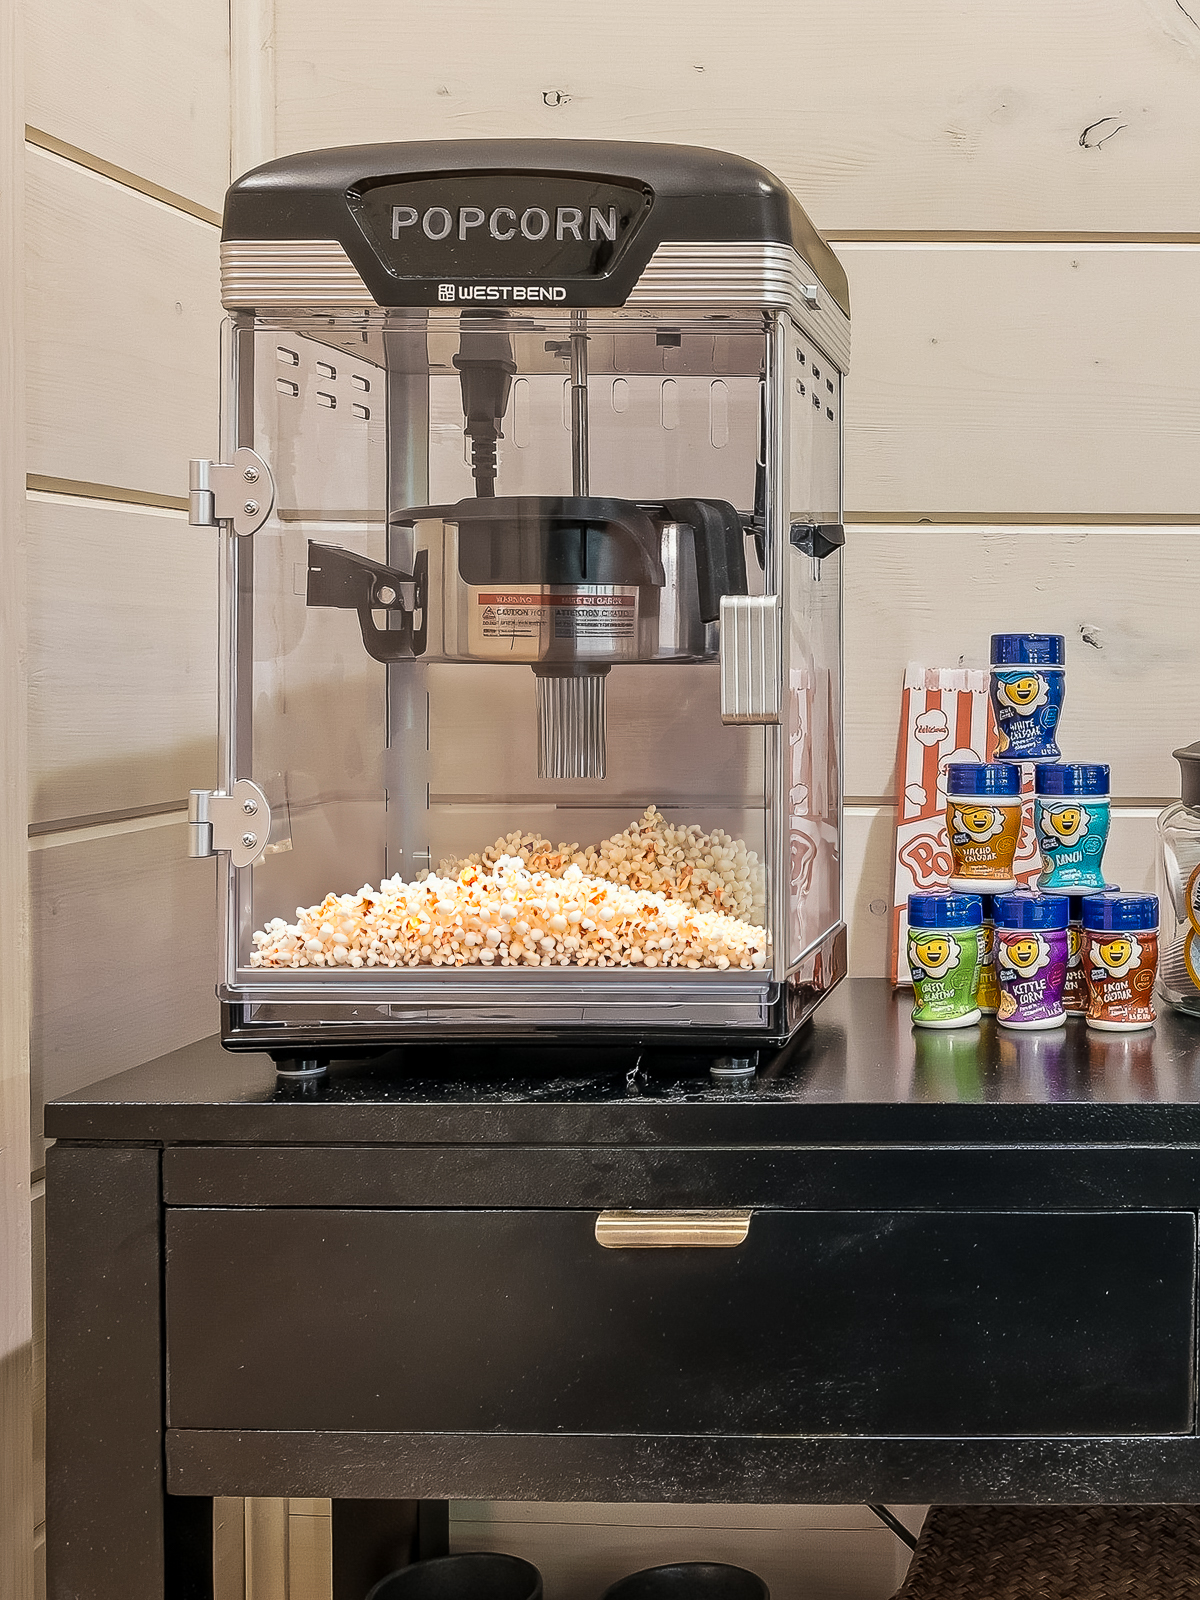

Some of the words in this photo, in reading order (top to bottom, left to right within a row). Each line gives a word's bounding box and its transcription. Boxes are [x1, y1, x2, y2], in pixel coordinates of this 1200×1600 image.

[391, 205, 618, 241] POPCORN
[1012, 978, 1047, 996] KETTLE
[1019, 990, 1044, 1004] CORN
